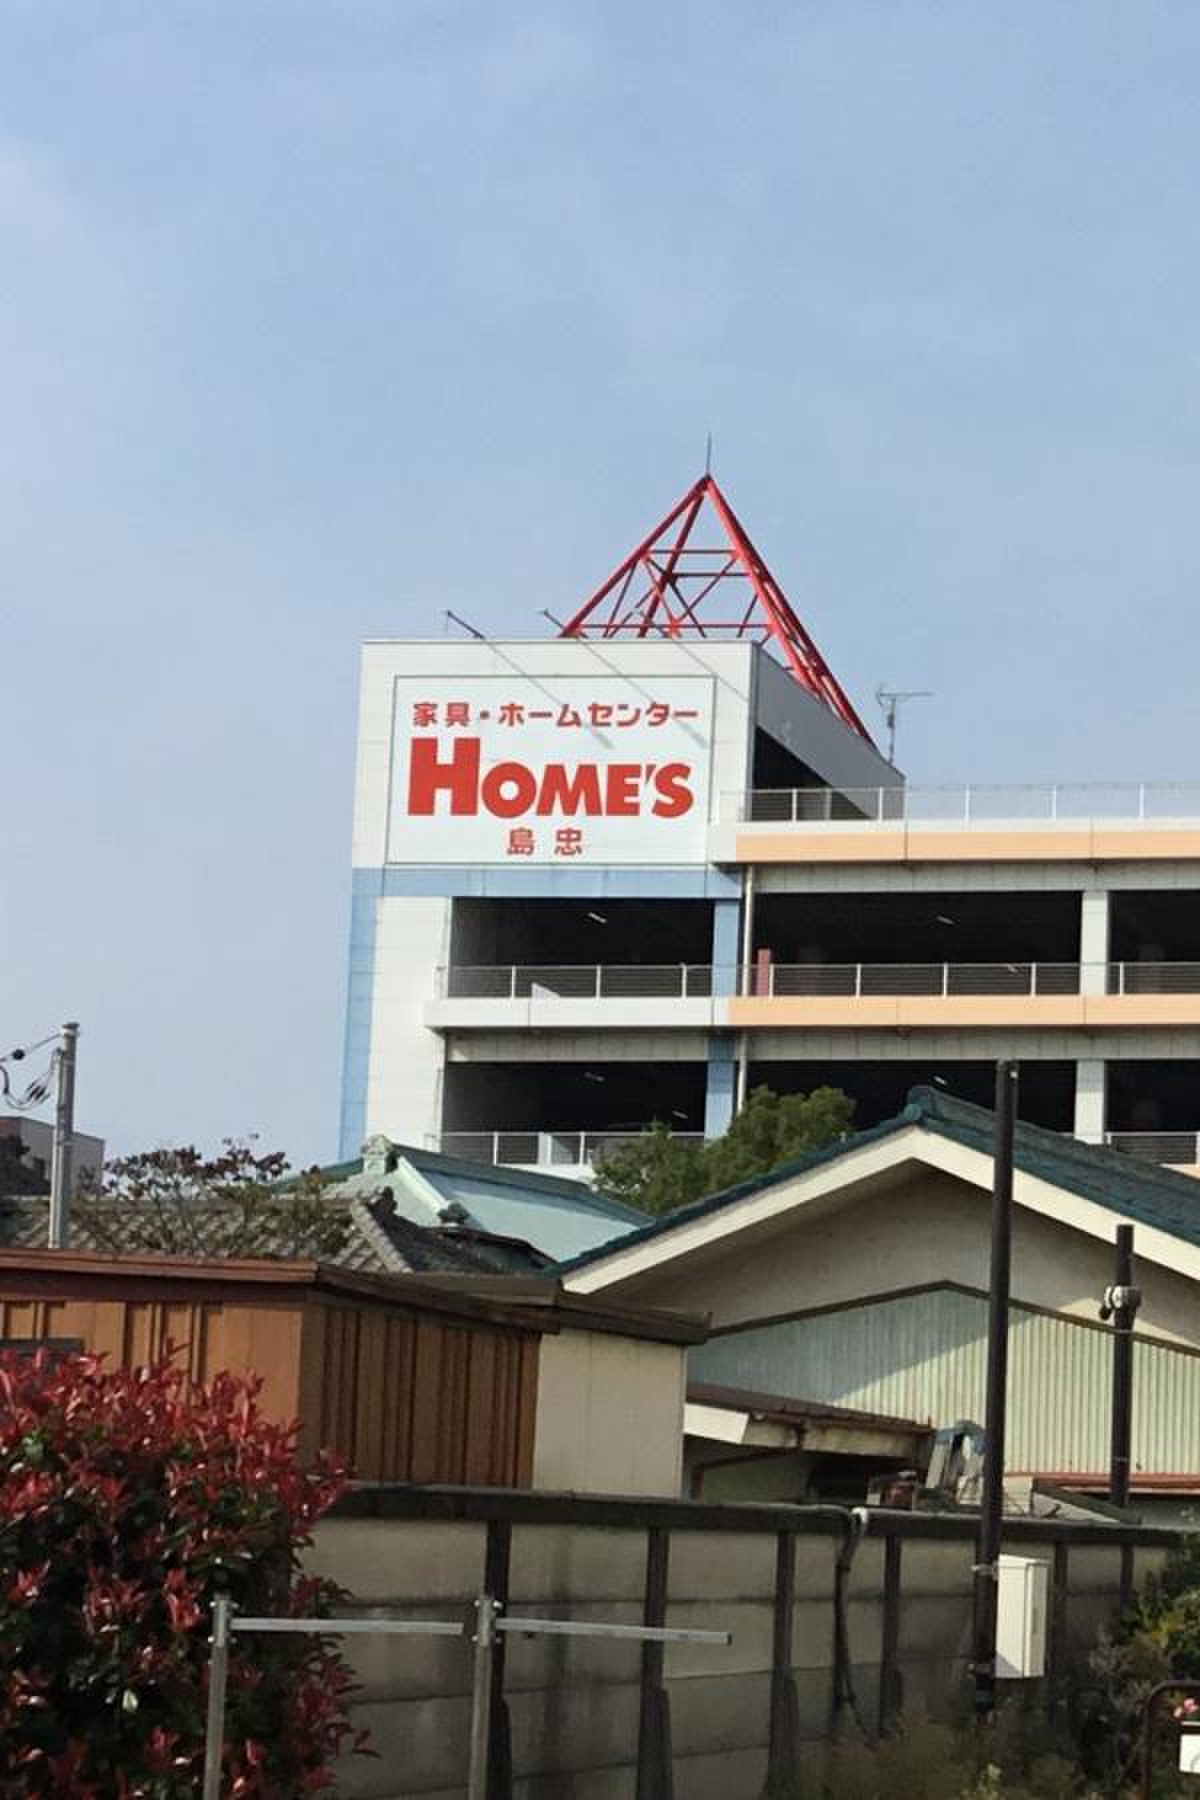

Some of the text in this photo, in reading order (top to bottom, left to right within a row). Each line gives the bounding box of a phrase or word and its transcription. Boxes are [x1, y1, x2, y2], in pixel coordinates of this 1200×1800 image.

[412, 702, 698, 727] 家具・ホームセンター
[407, 737, 694, 818] HOME'S
